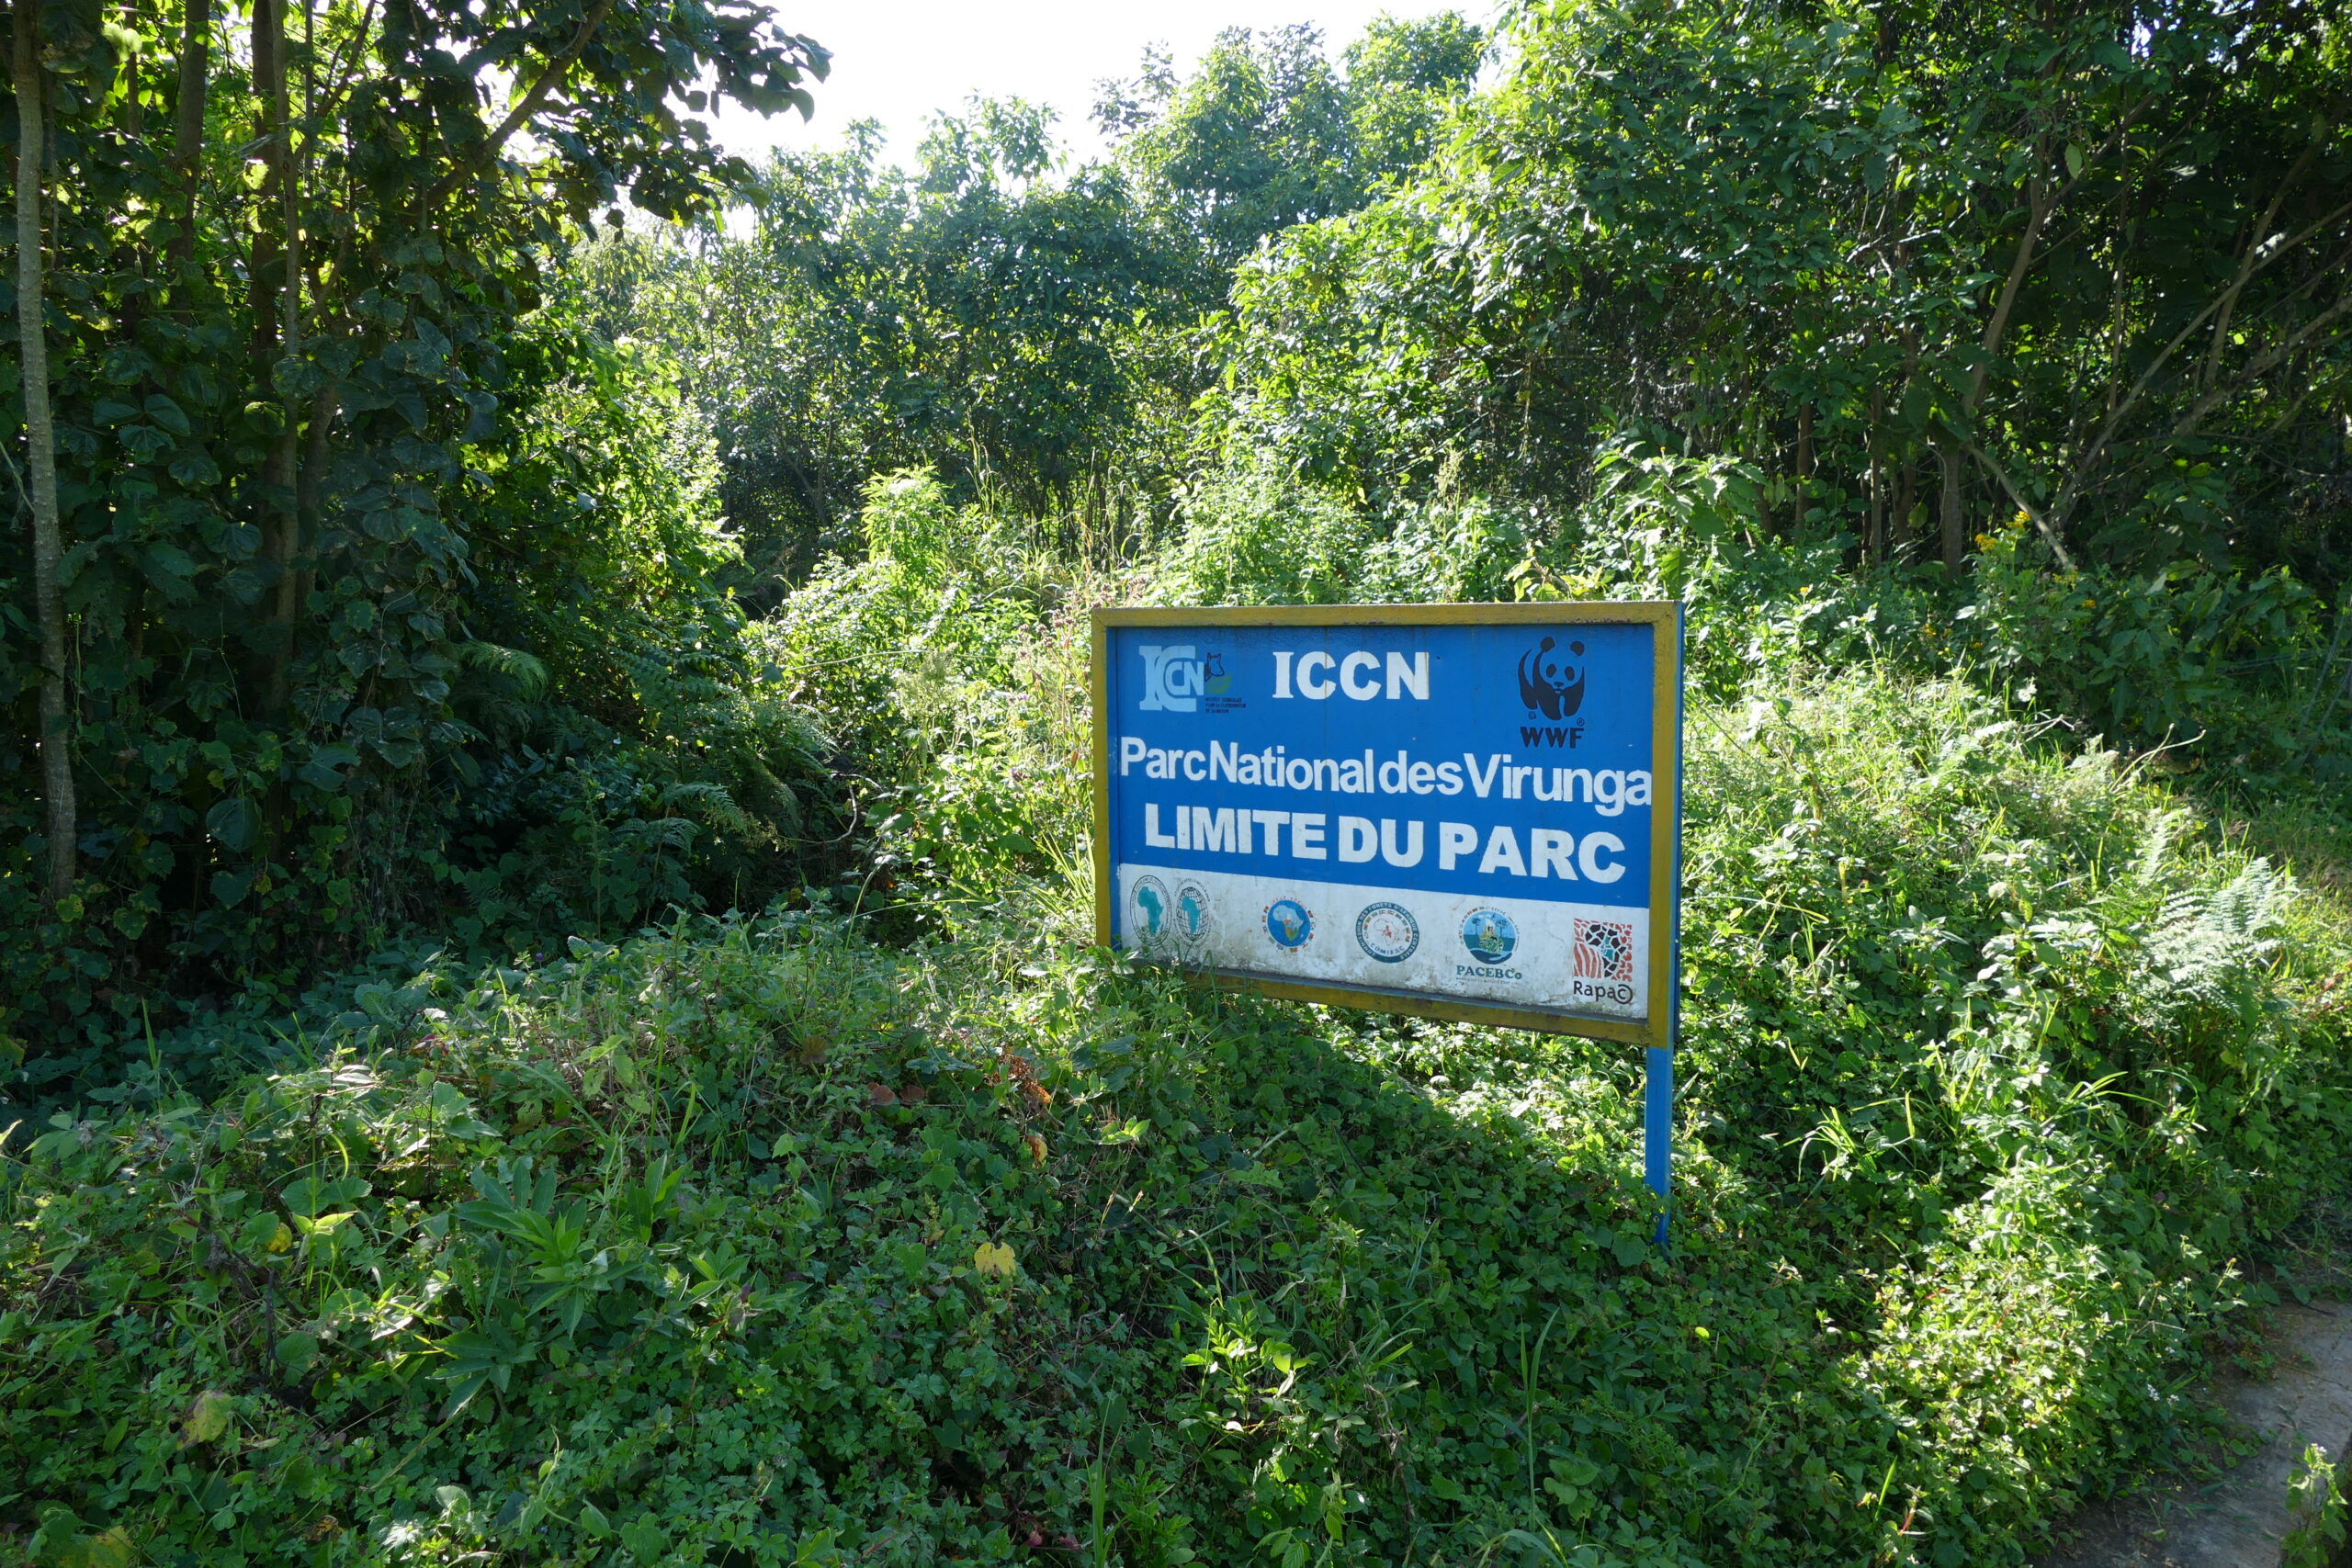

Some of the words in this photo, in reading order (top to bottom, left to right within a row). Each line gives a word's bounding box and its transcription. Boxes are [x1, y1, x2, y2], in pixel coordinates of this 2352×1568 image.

[1272, 650, 1430, 701] ICCN
[1120, 736, 1206, 782] Parc
[1209, 739, 1375, 794] National
[1378, 750, 1464, 795] des
[1520, 727, 1585, 749] WWF
[1145, 802, 1328, 861] LIMITE
[1338, 815, 1425, 868] DU
[1439, 821, 1626, 885] PARC
